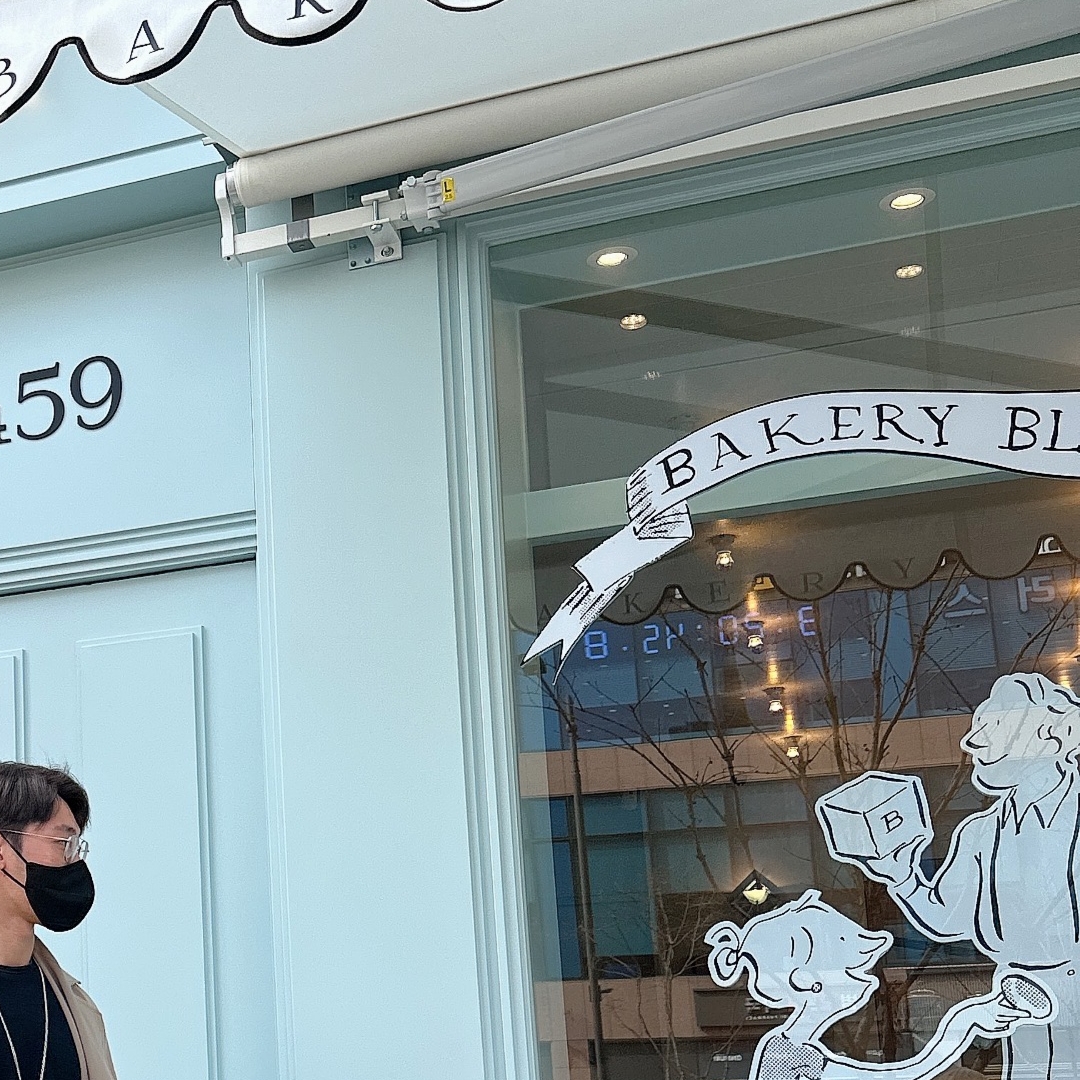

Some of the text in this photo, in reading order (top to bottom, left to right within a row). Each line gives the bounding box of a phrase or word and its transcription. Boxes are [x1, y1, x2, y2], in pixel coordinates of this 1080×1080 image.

[444, 181, 451, 192] L
[657, 403, 960, 496] BAKERY
[880, 810, 904, 835] B
